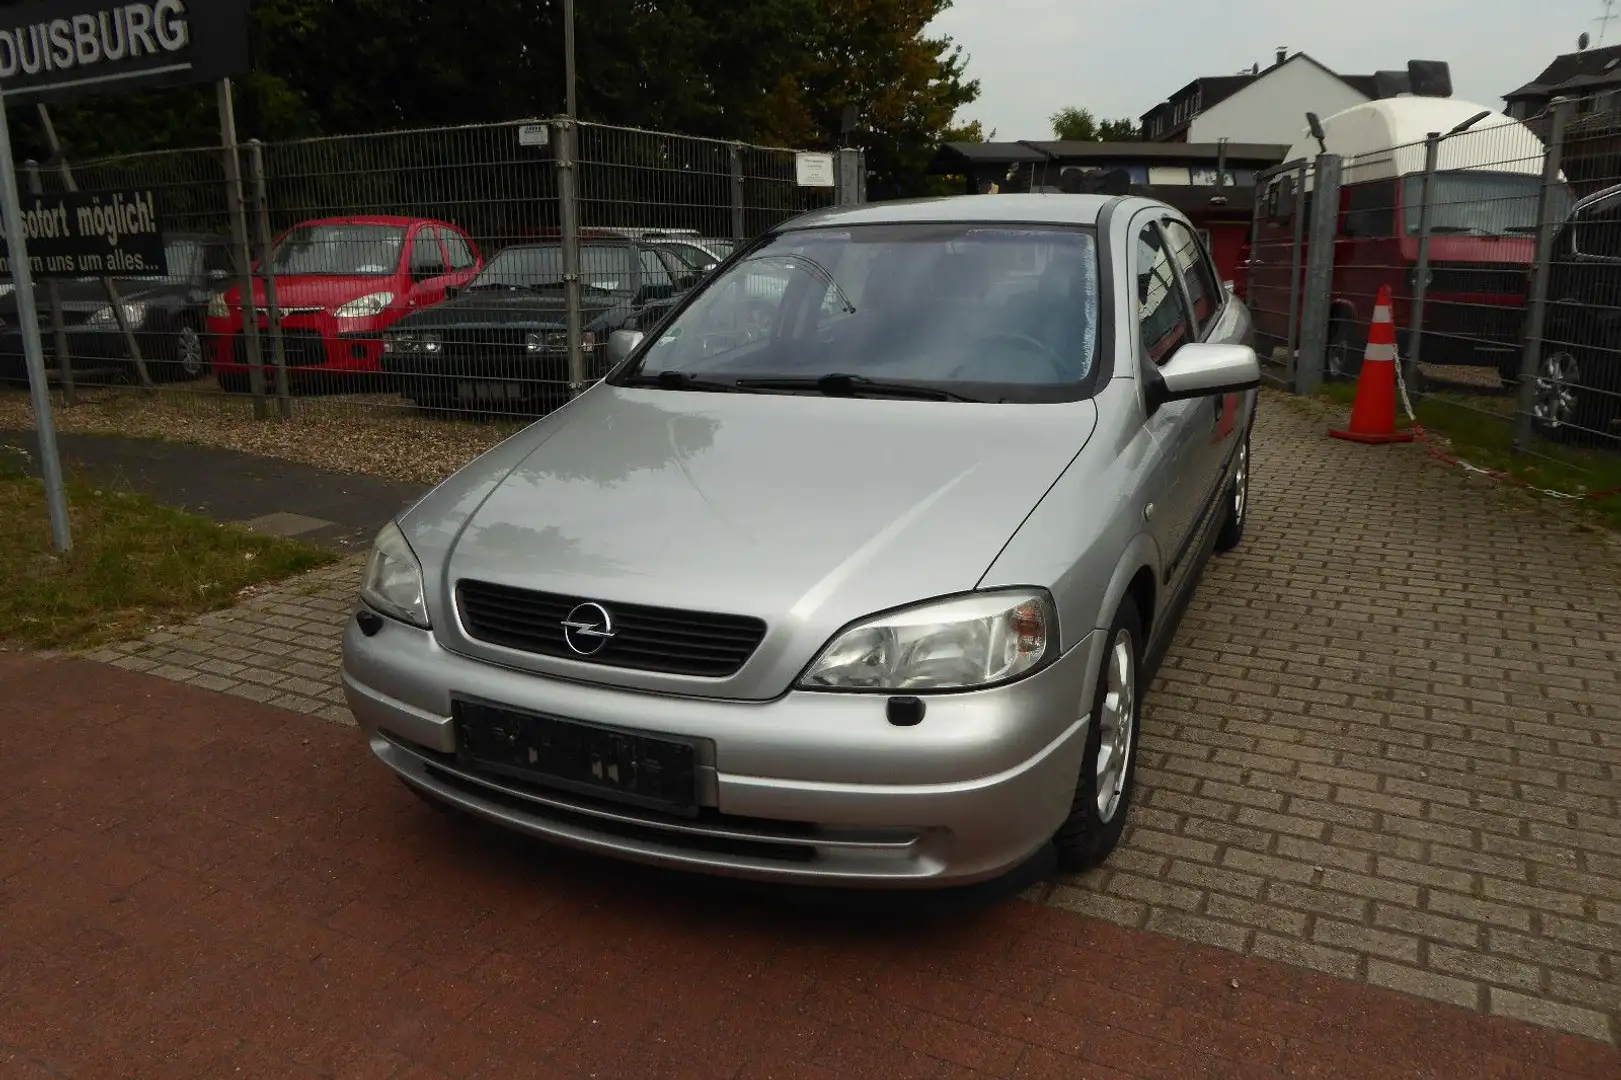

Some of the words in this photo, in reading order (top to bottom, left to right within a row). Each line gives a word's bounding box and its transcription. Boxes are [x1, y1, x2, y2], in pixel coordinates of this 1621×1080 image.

[0, 0, 189, 78] DUISBURG
[76, 191, 156, 246] möglich!
[47, 255, 75, 272] uns
[79, 254, 102, 271] um
